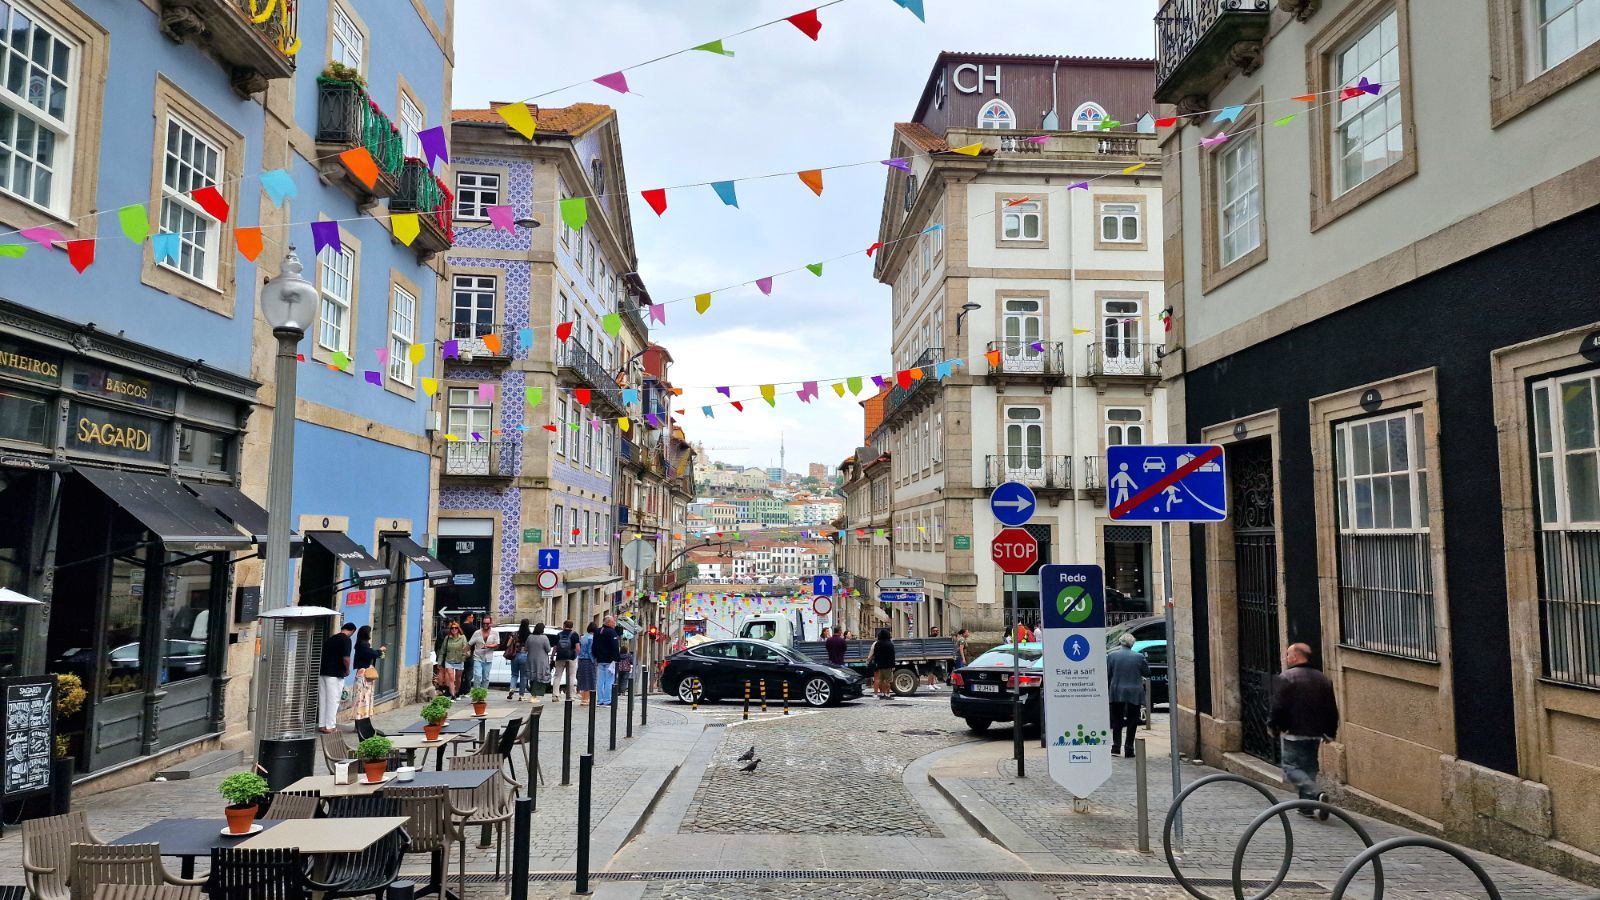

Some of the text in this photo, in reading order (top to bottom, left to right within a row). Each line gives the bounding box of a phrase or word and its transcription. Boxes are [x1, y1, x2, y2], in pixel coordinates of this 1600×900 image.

[953, 63, 1001, 94] CH
[106, 378, 148, 399] BASCOS
[77, 417, 151, 452] SAGARDI
[993, 543, 1036, 558] STOP
[1060, 573, 1087, 582] Rede
[1063, 597, 1086, 612] 20
